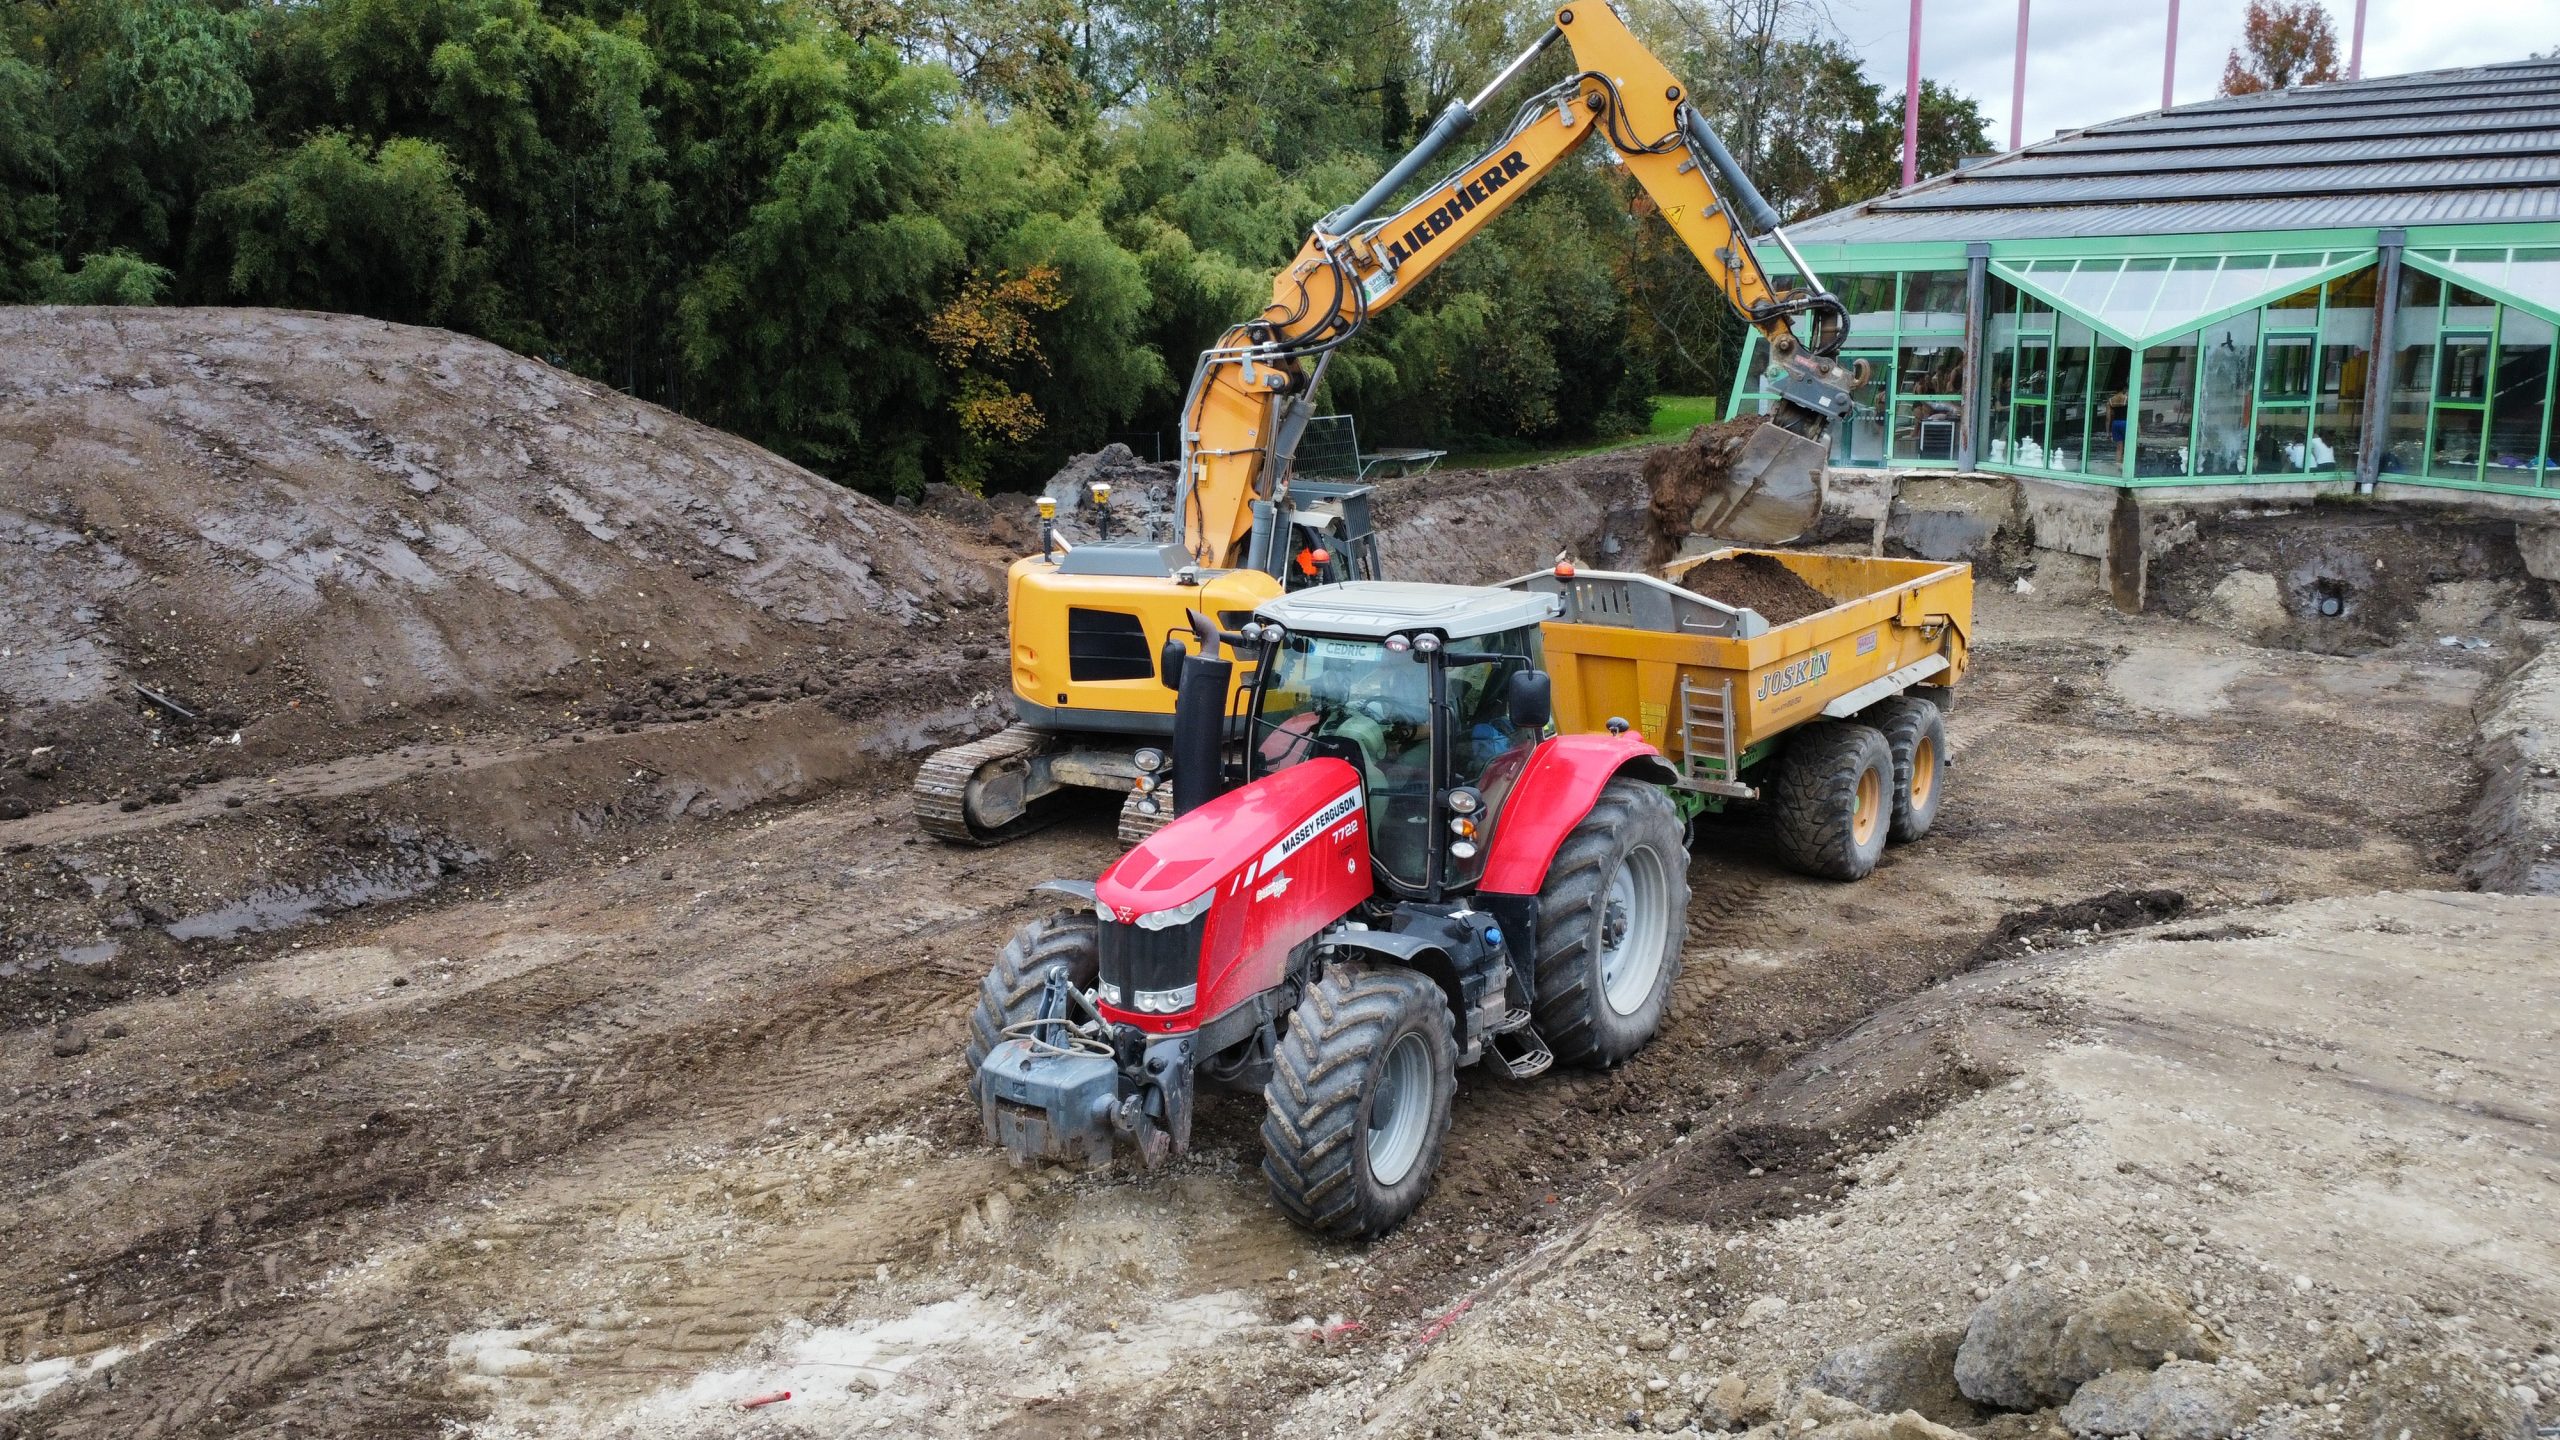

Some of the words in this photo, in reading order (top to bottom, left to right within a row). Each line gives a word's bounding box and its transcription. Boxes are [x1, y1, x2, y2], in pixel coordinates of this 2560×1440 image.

[1390, 151, 1530, 264] LIEBHERR
[1326, 642, 1367, 657] CEDRIC
[1757, 650, 1831, 701] JOSKIN
[1281, 821, 1314, 855] MASSEY
[1315, 796, 1356, 831] FERGUSON
[1332, 819, 1359, 845] 7722
